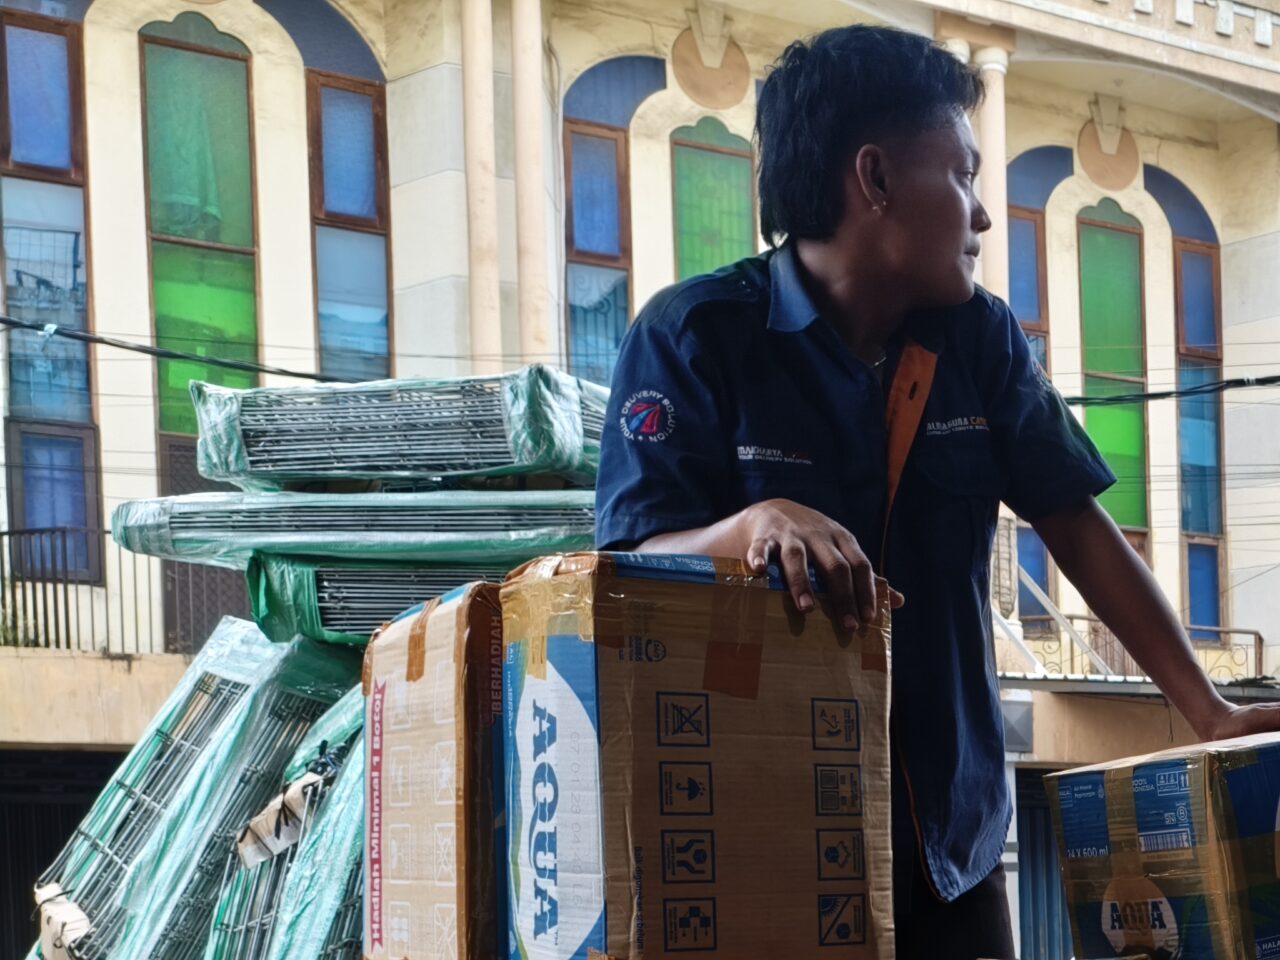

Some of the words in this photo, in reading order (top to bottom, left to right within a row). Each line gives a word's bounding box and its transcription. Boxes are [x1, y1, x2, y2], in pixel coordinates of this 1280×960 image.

[371, 772, 382, 853] Minimal
[529, 698, 560, 940] AQUA
[371, 865, 382, 939] Hadiah
[1110, 901, 1165, 931] AQUA
